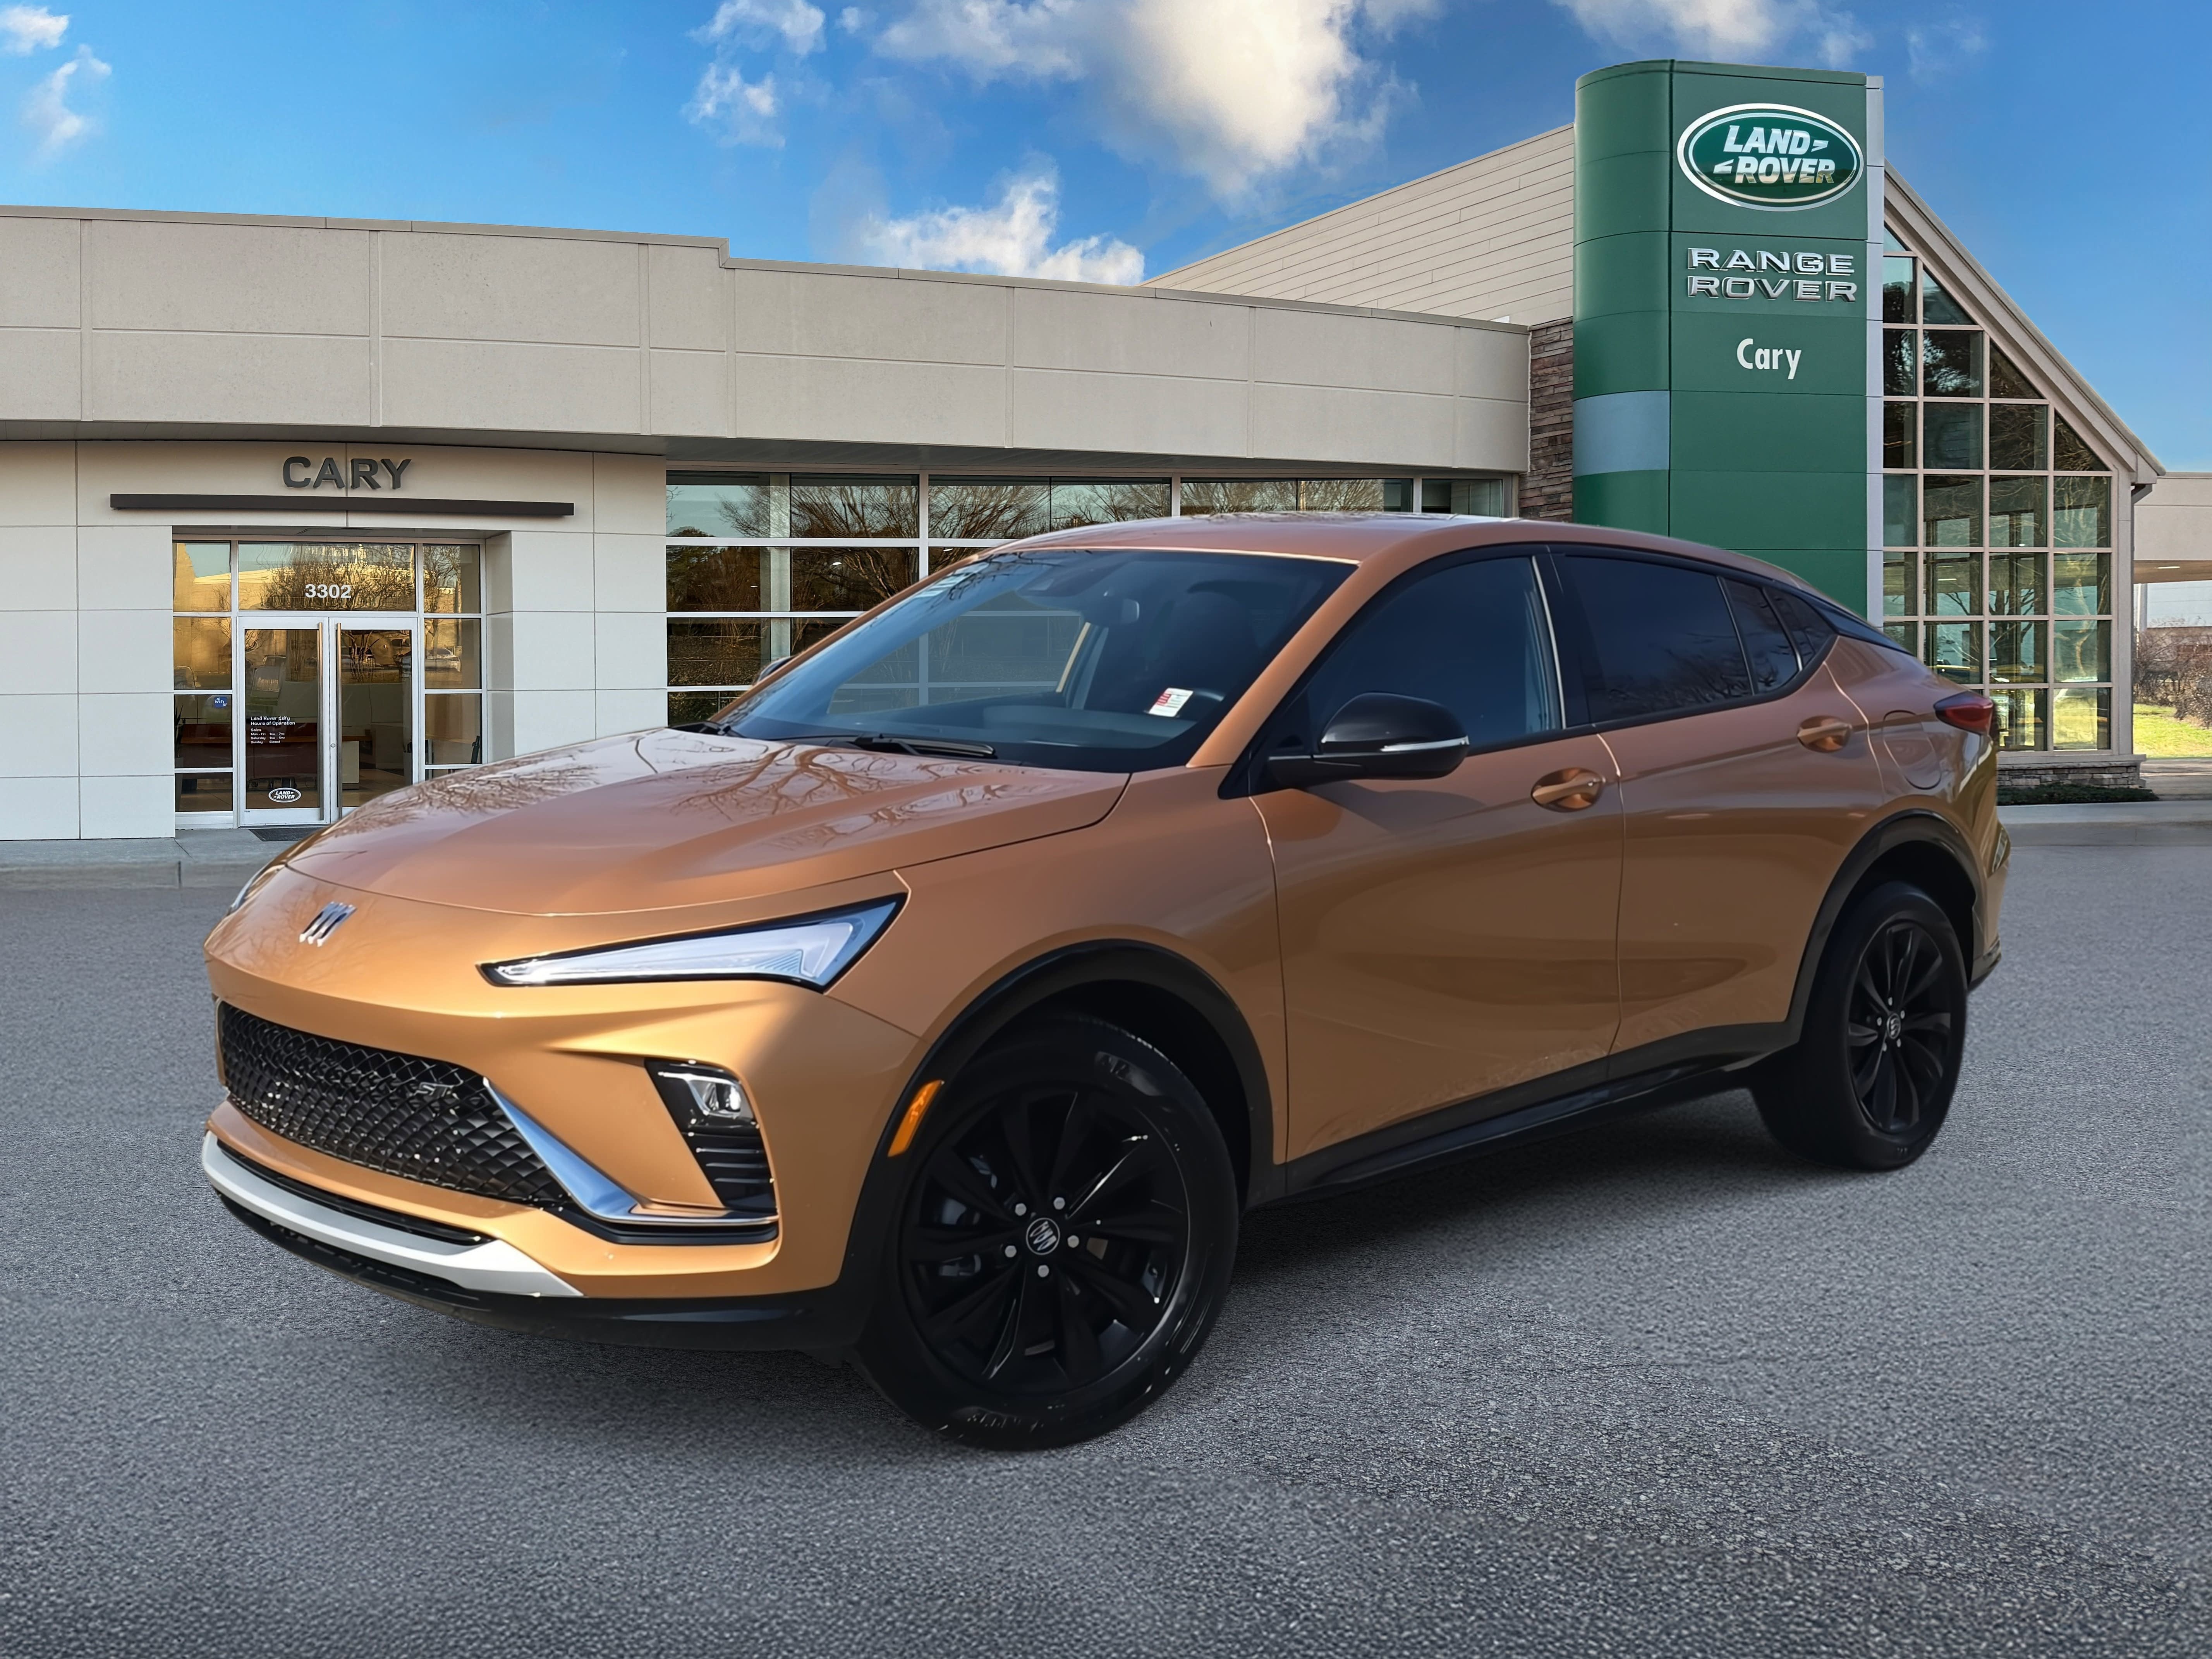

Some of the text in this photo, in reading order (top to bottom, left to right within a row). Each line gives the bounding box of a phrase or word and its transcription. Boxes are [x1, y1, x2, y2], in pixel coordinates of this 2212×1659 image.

[1723, 125, 1811, 155] LAND
[1735, 156, 1836, 184] ROVER
[1687, 248, 1855, 276] RANGE
[1687, 275, 1858, 302] ROVER
[1737, 338, 1802, 380] Cary
[282, 456, 412, 489] CARY
[304, 584, 352, 599] 3302
